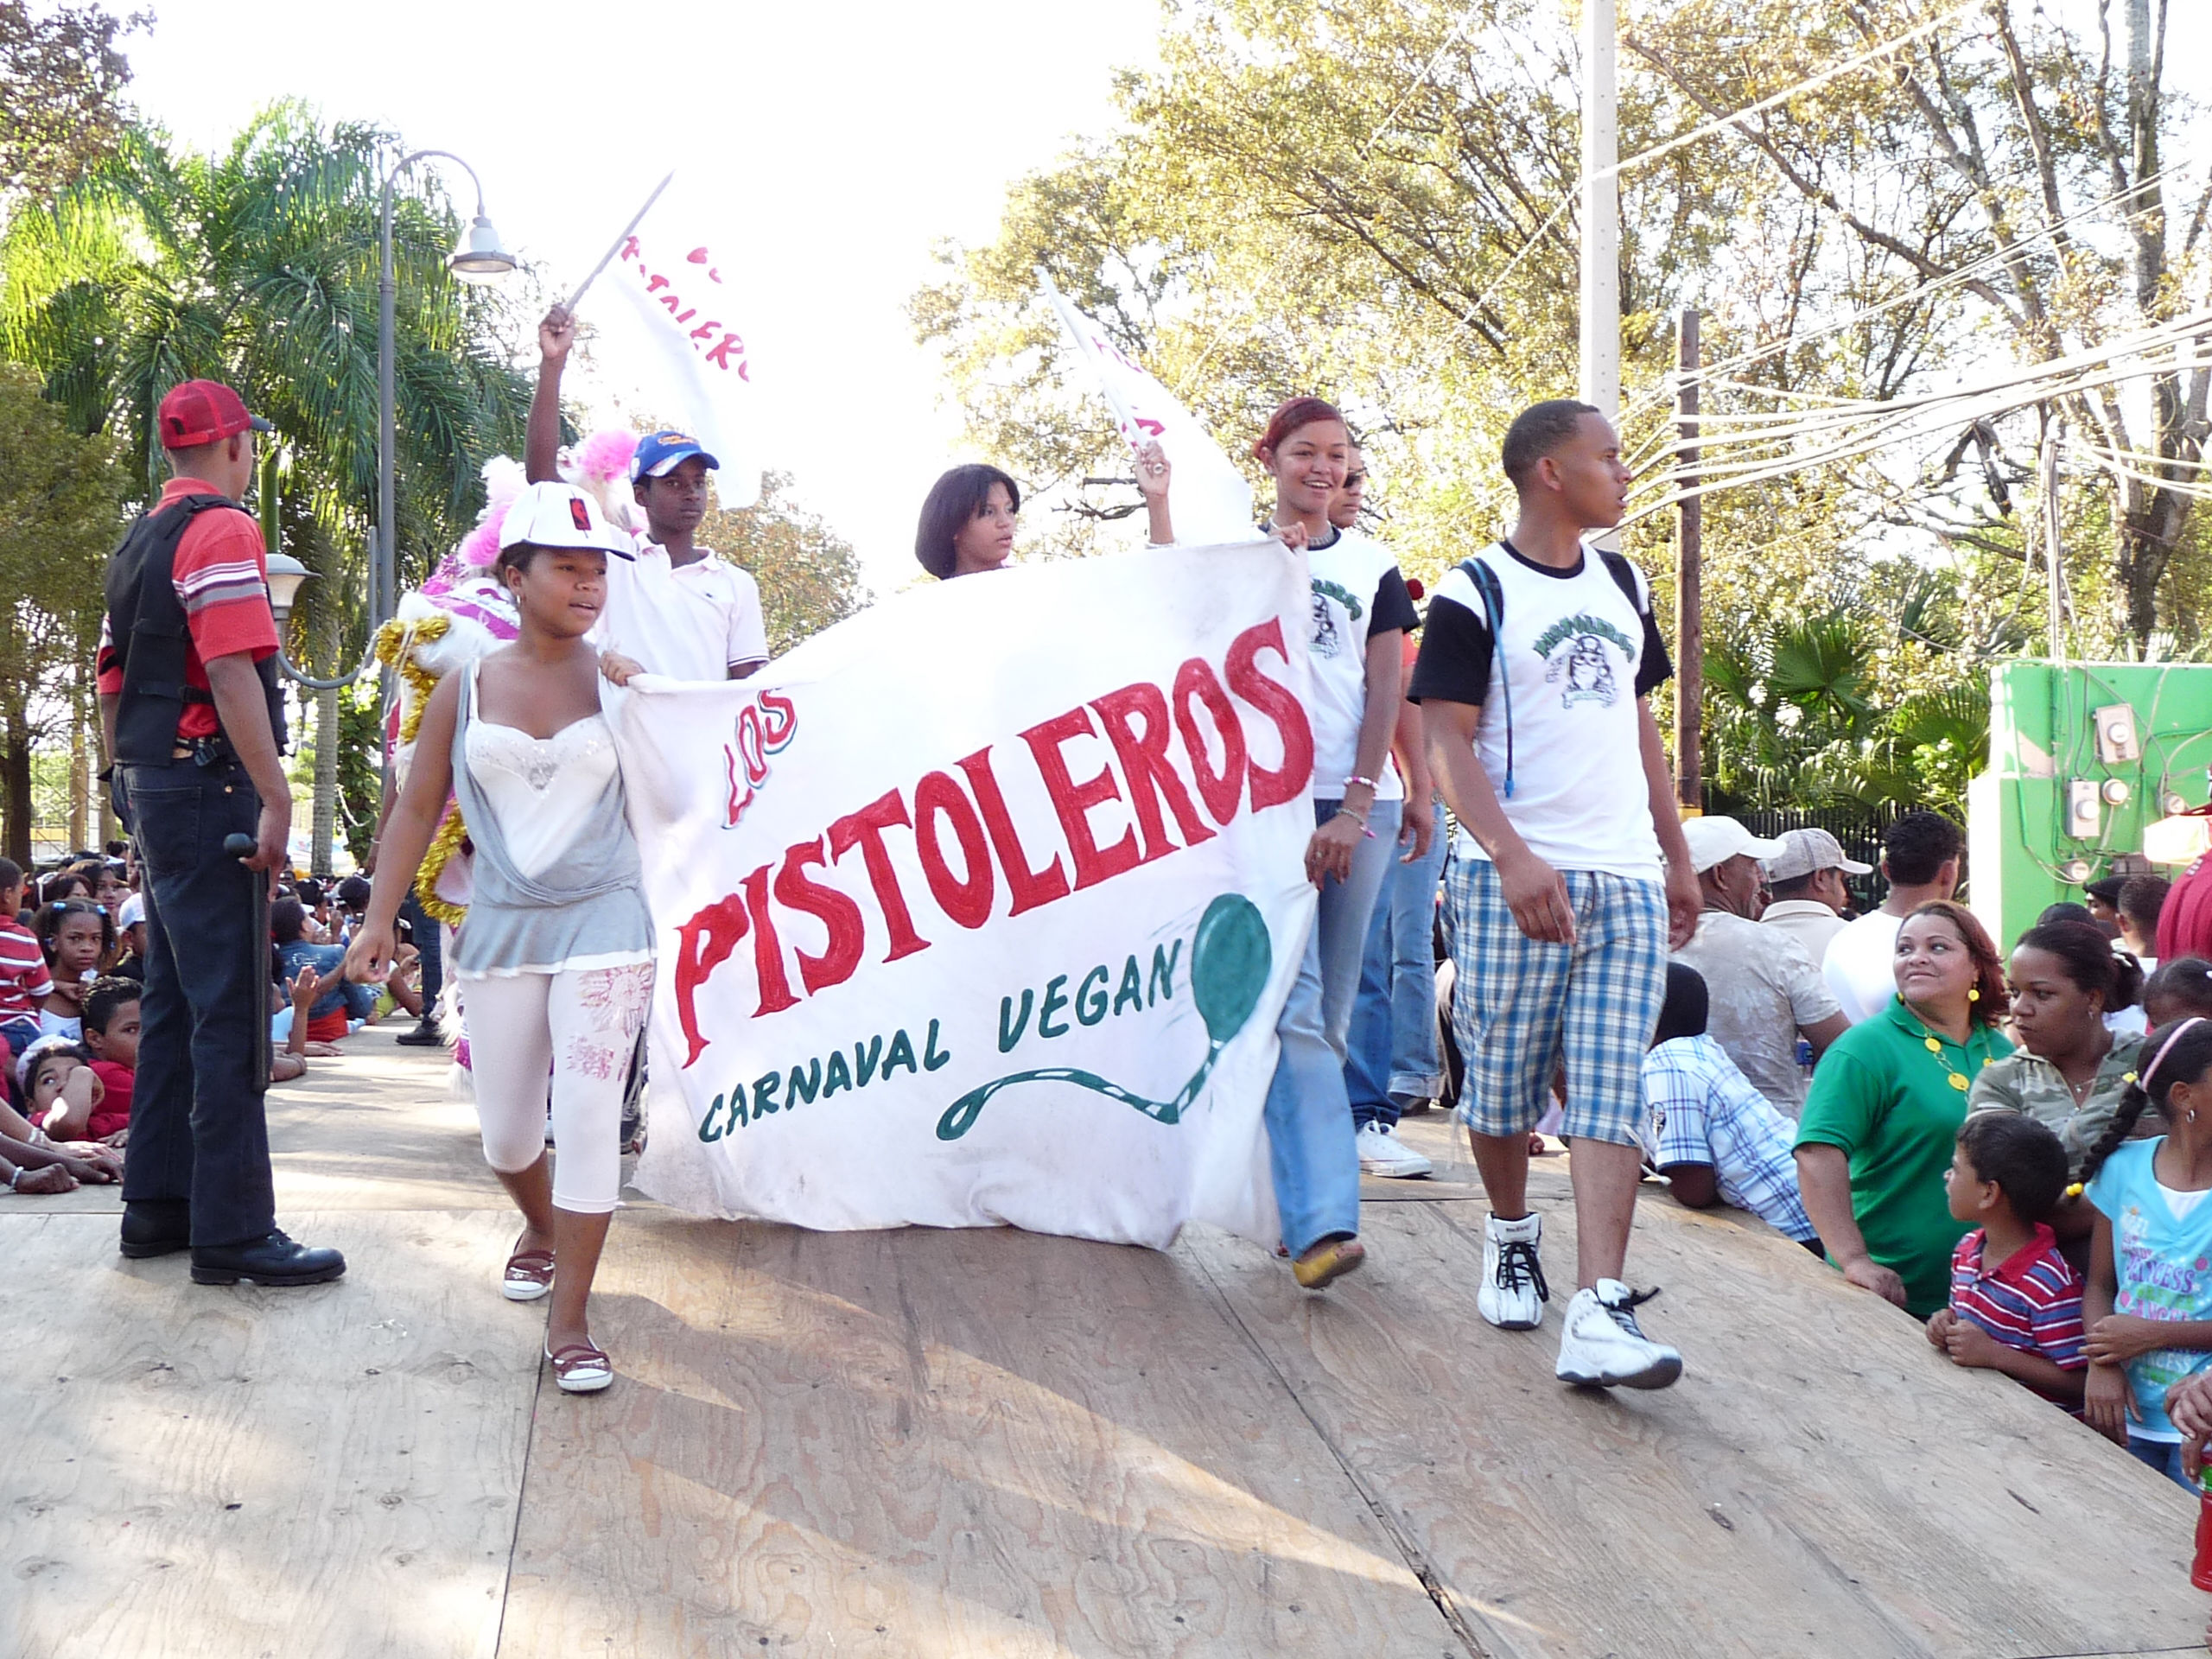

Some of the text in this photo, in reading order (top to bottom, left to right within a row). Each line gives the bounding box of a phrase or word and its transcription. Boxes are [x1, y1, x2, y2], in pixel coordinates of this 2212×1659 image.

[674, 616, 1315, 1070] PISTOLEROS
[722, 688, 798, 830] LOS
[698, 938, 1182, 1143] CARNAVAL VEGAN
